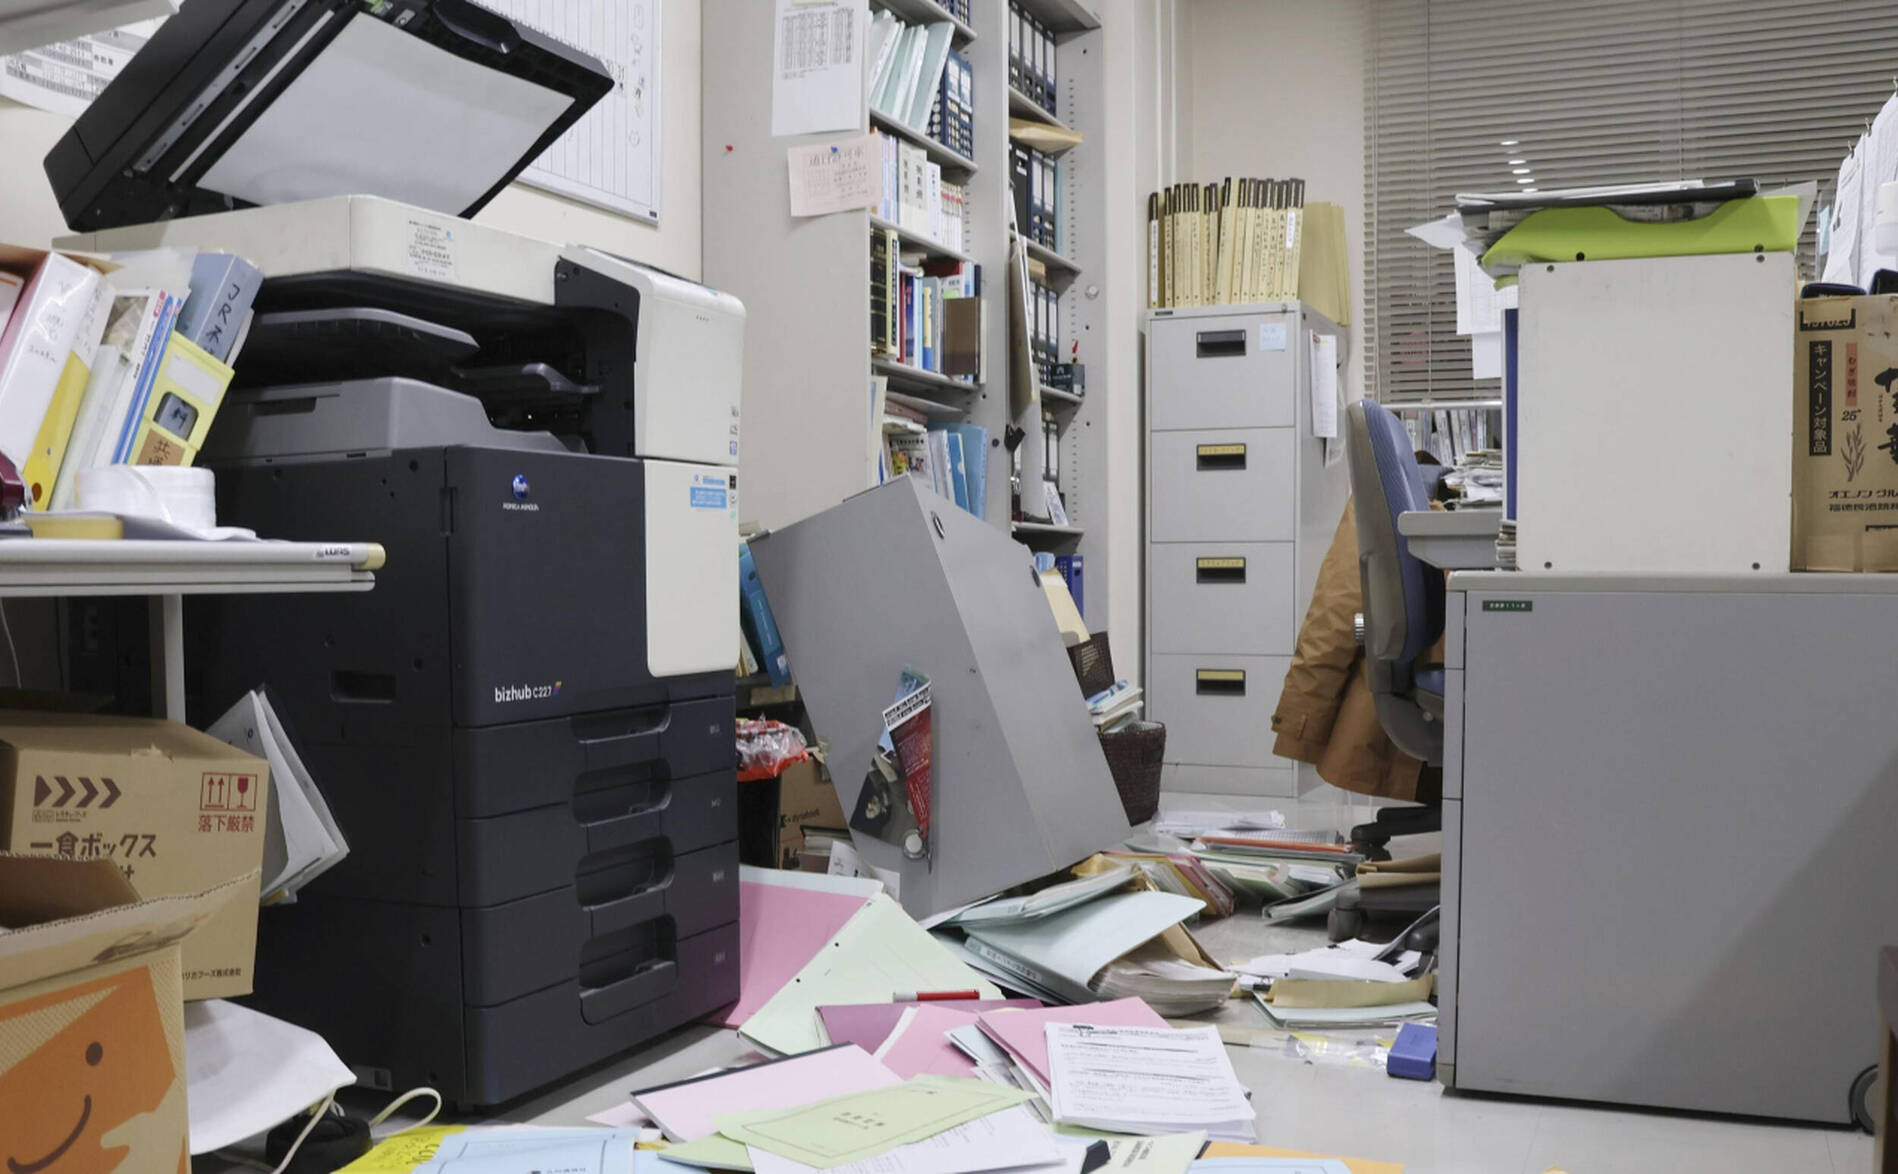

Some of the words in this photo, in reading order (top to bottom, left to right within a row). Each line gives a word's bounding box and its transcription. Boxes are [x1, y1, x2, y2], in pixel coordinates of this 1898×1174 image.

[1814, 344, 1828, 455] キャンペーン対象品
[494, 684, 532, 702] bizhub
[198, 814, 254, 832] 落下厳禁
[30, 831, 157, 857] 一食ボックス
